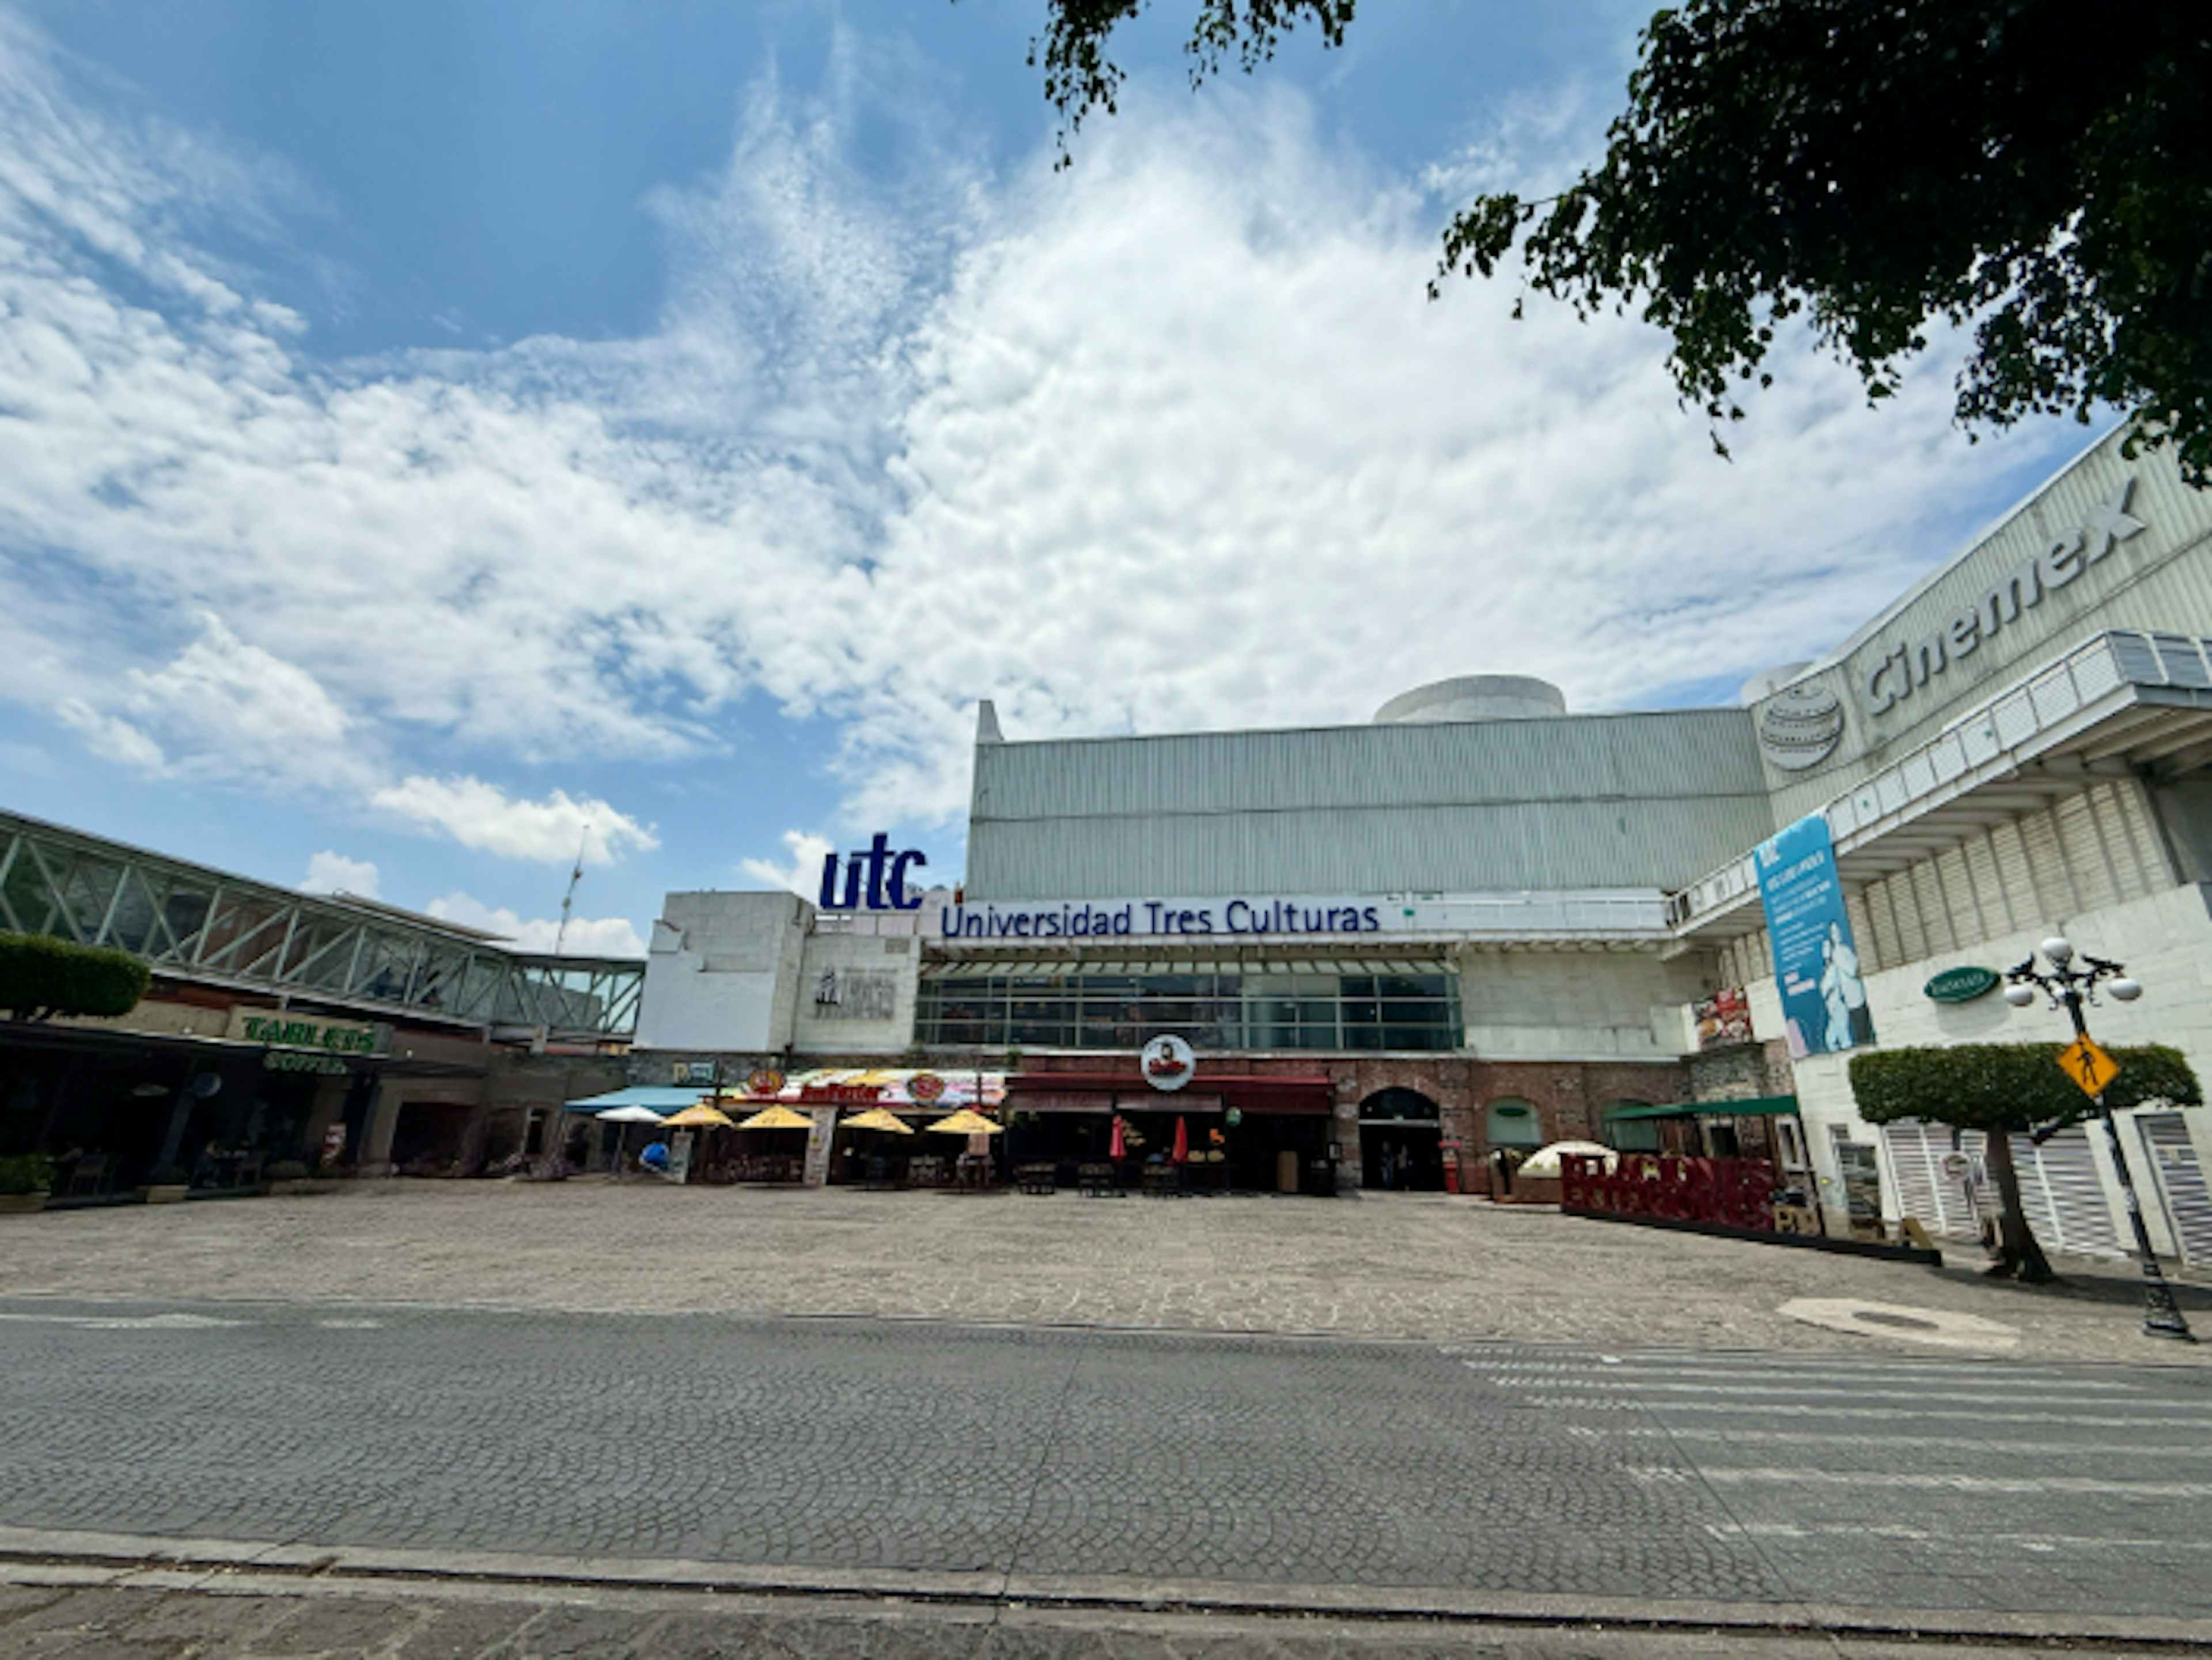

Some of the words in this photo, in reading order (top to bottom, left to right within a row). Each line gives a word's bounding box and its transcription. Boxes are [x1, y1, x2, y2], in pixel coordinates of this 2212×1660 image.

[1865, 479, 2146, 716] Cinemex
[820, 832, 926, 909] utc
[941, 903, 1130, 937] Universidad
[1143, 901, 1213, 934] Tres
[1226, 899, 1380, 933] Culturas
